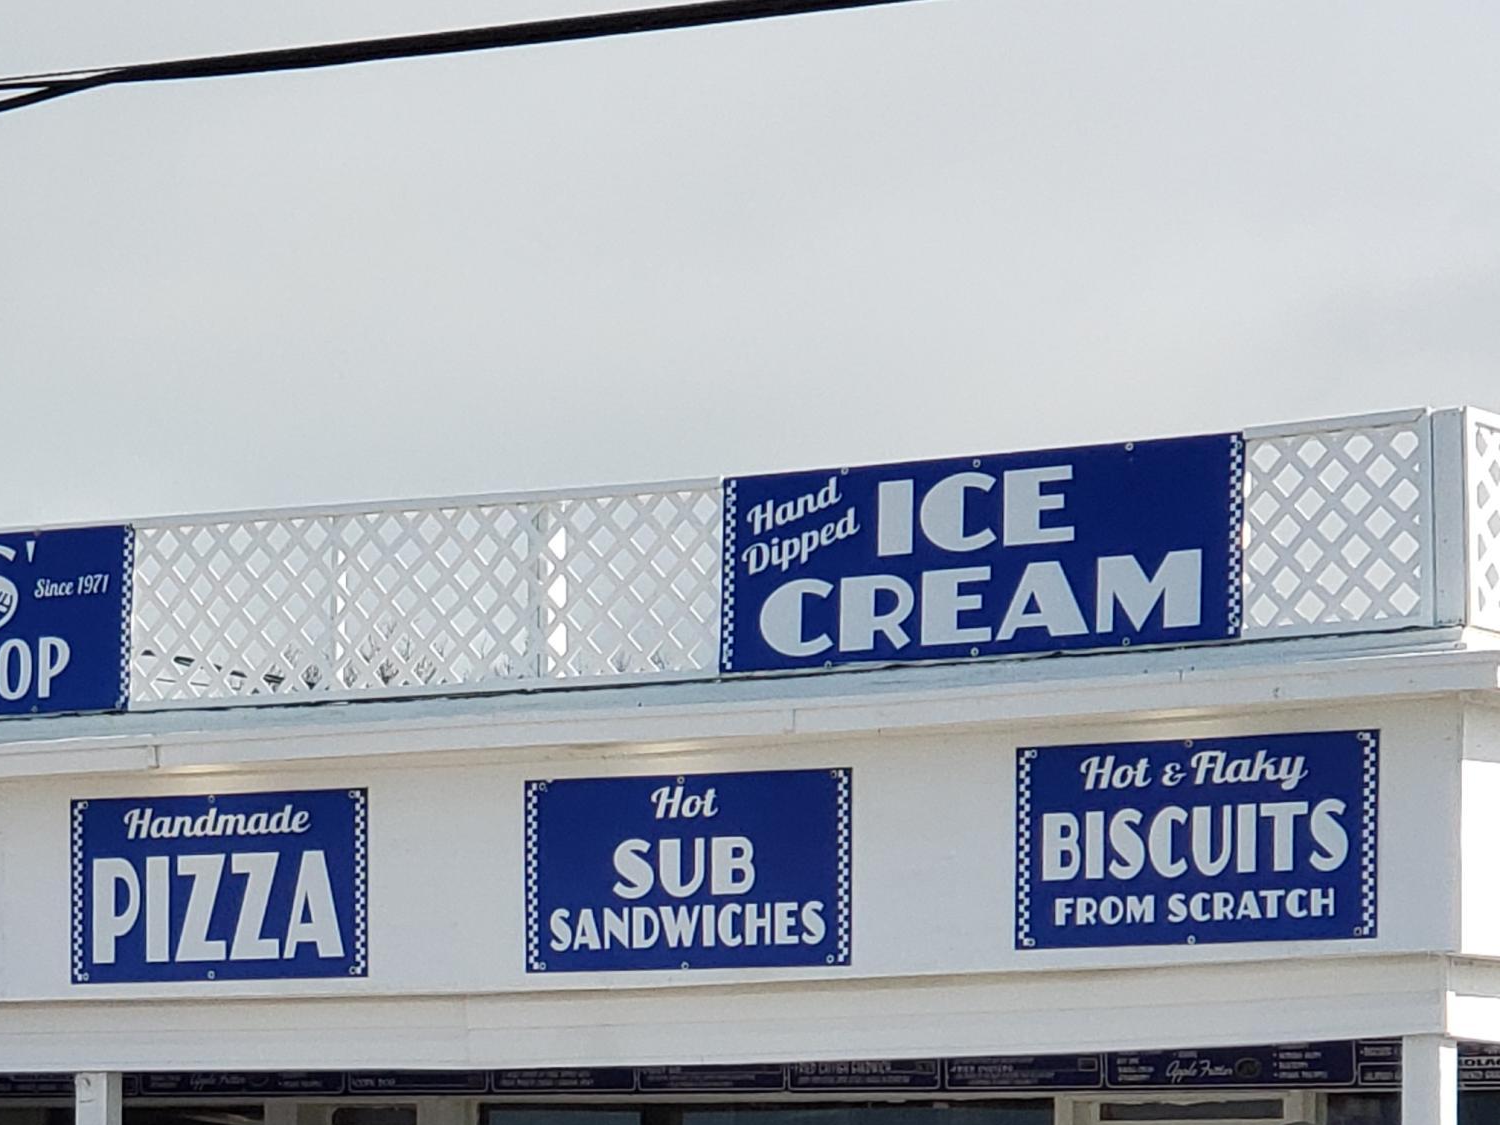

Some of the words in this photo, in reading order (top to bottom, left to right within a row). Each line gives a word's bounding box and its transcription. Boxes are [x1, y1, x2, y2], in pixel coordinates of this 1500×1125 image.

[747, 477, 841, 535] Hand
[878, 465, 1074, 556] ICE
[742, 510, 860, 575] Dipped
[34, 579, 73, 598] Since
[78, 574, 109, 594] 1971
[760, 549, 1202, 656] CREAM
[1080, 756, 1151, 790] Hot
[1162, 763, 1186, 786] &
[1191, 750, 1308, 790] Flaky
[124, 805, 309, 839] Handmade
[651, 786, 717, 818] Hot
[613, 837, 754, 899] SUB
[1042, 799, 1348, 881] BISCUITS
[93, 850, 344, 963] PIZZA
[550, 901, 825, 951] SANDWICHES
[1055, 895, 1154, 925] FROM
[1168, 888, 1334, 922] SCRATCH
